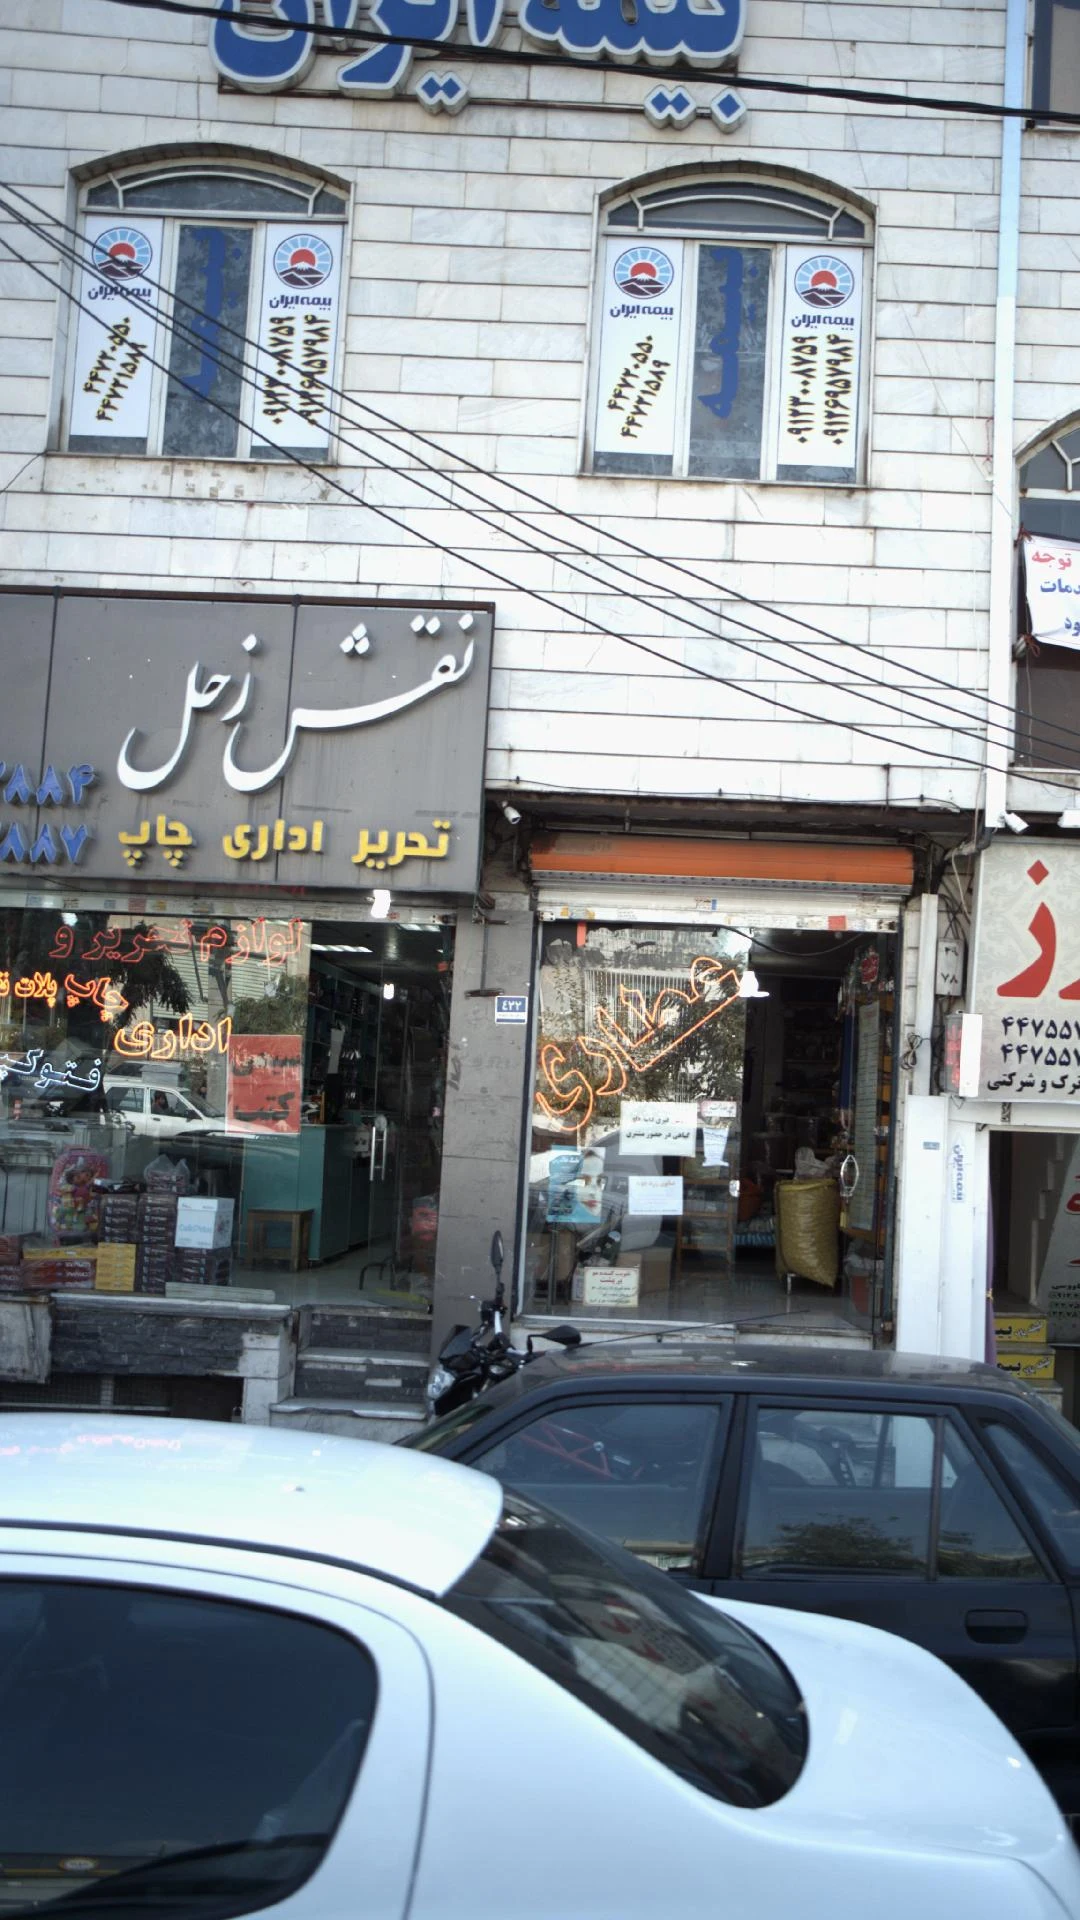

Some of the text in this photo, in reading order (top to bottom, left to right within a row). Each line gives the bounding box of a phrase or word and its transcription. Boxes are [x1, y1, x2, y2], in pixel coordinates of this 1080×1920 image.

[269, 295, 332, 310] بیمه ایران
[610, 304, 674, 320] بیمه ایران
[791, 314, 854, 330] بیمه ایران
[1032, 550, 1072, 570] توجه
[1040, 578, 1080, 594] دمات
[117, 612, 474, 791] نقش زحل
[0, 761, 95, 805] ۸۸۴
[0, 822, 88, 863] ۸۸۷
[118, 814, 452, 869] تحریر اداری چاپ
[49, 925, 74, 959] و
[200, 917, 303, 965] لوازم
[64, 974, 129, 1022] چاپ
[114, 1012, 233, 1059] اداری
[536, 956, 742, 1131] عطاری
[987, 1072, 1035, 1092] شرکتی
[1039, 1080, 1047, 1093] و
